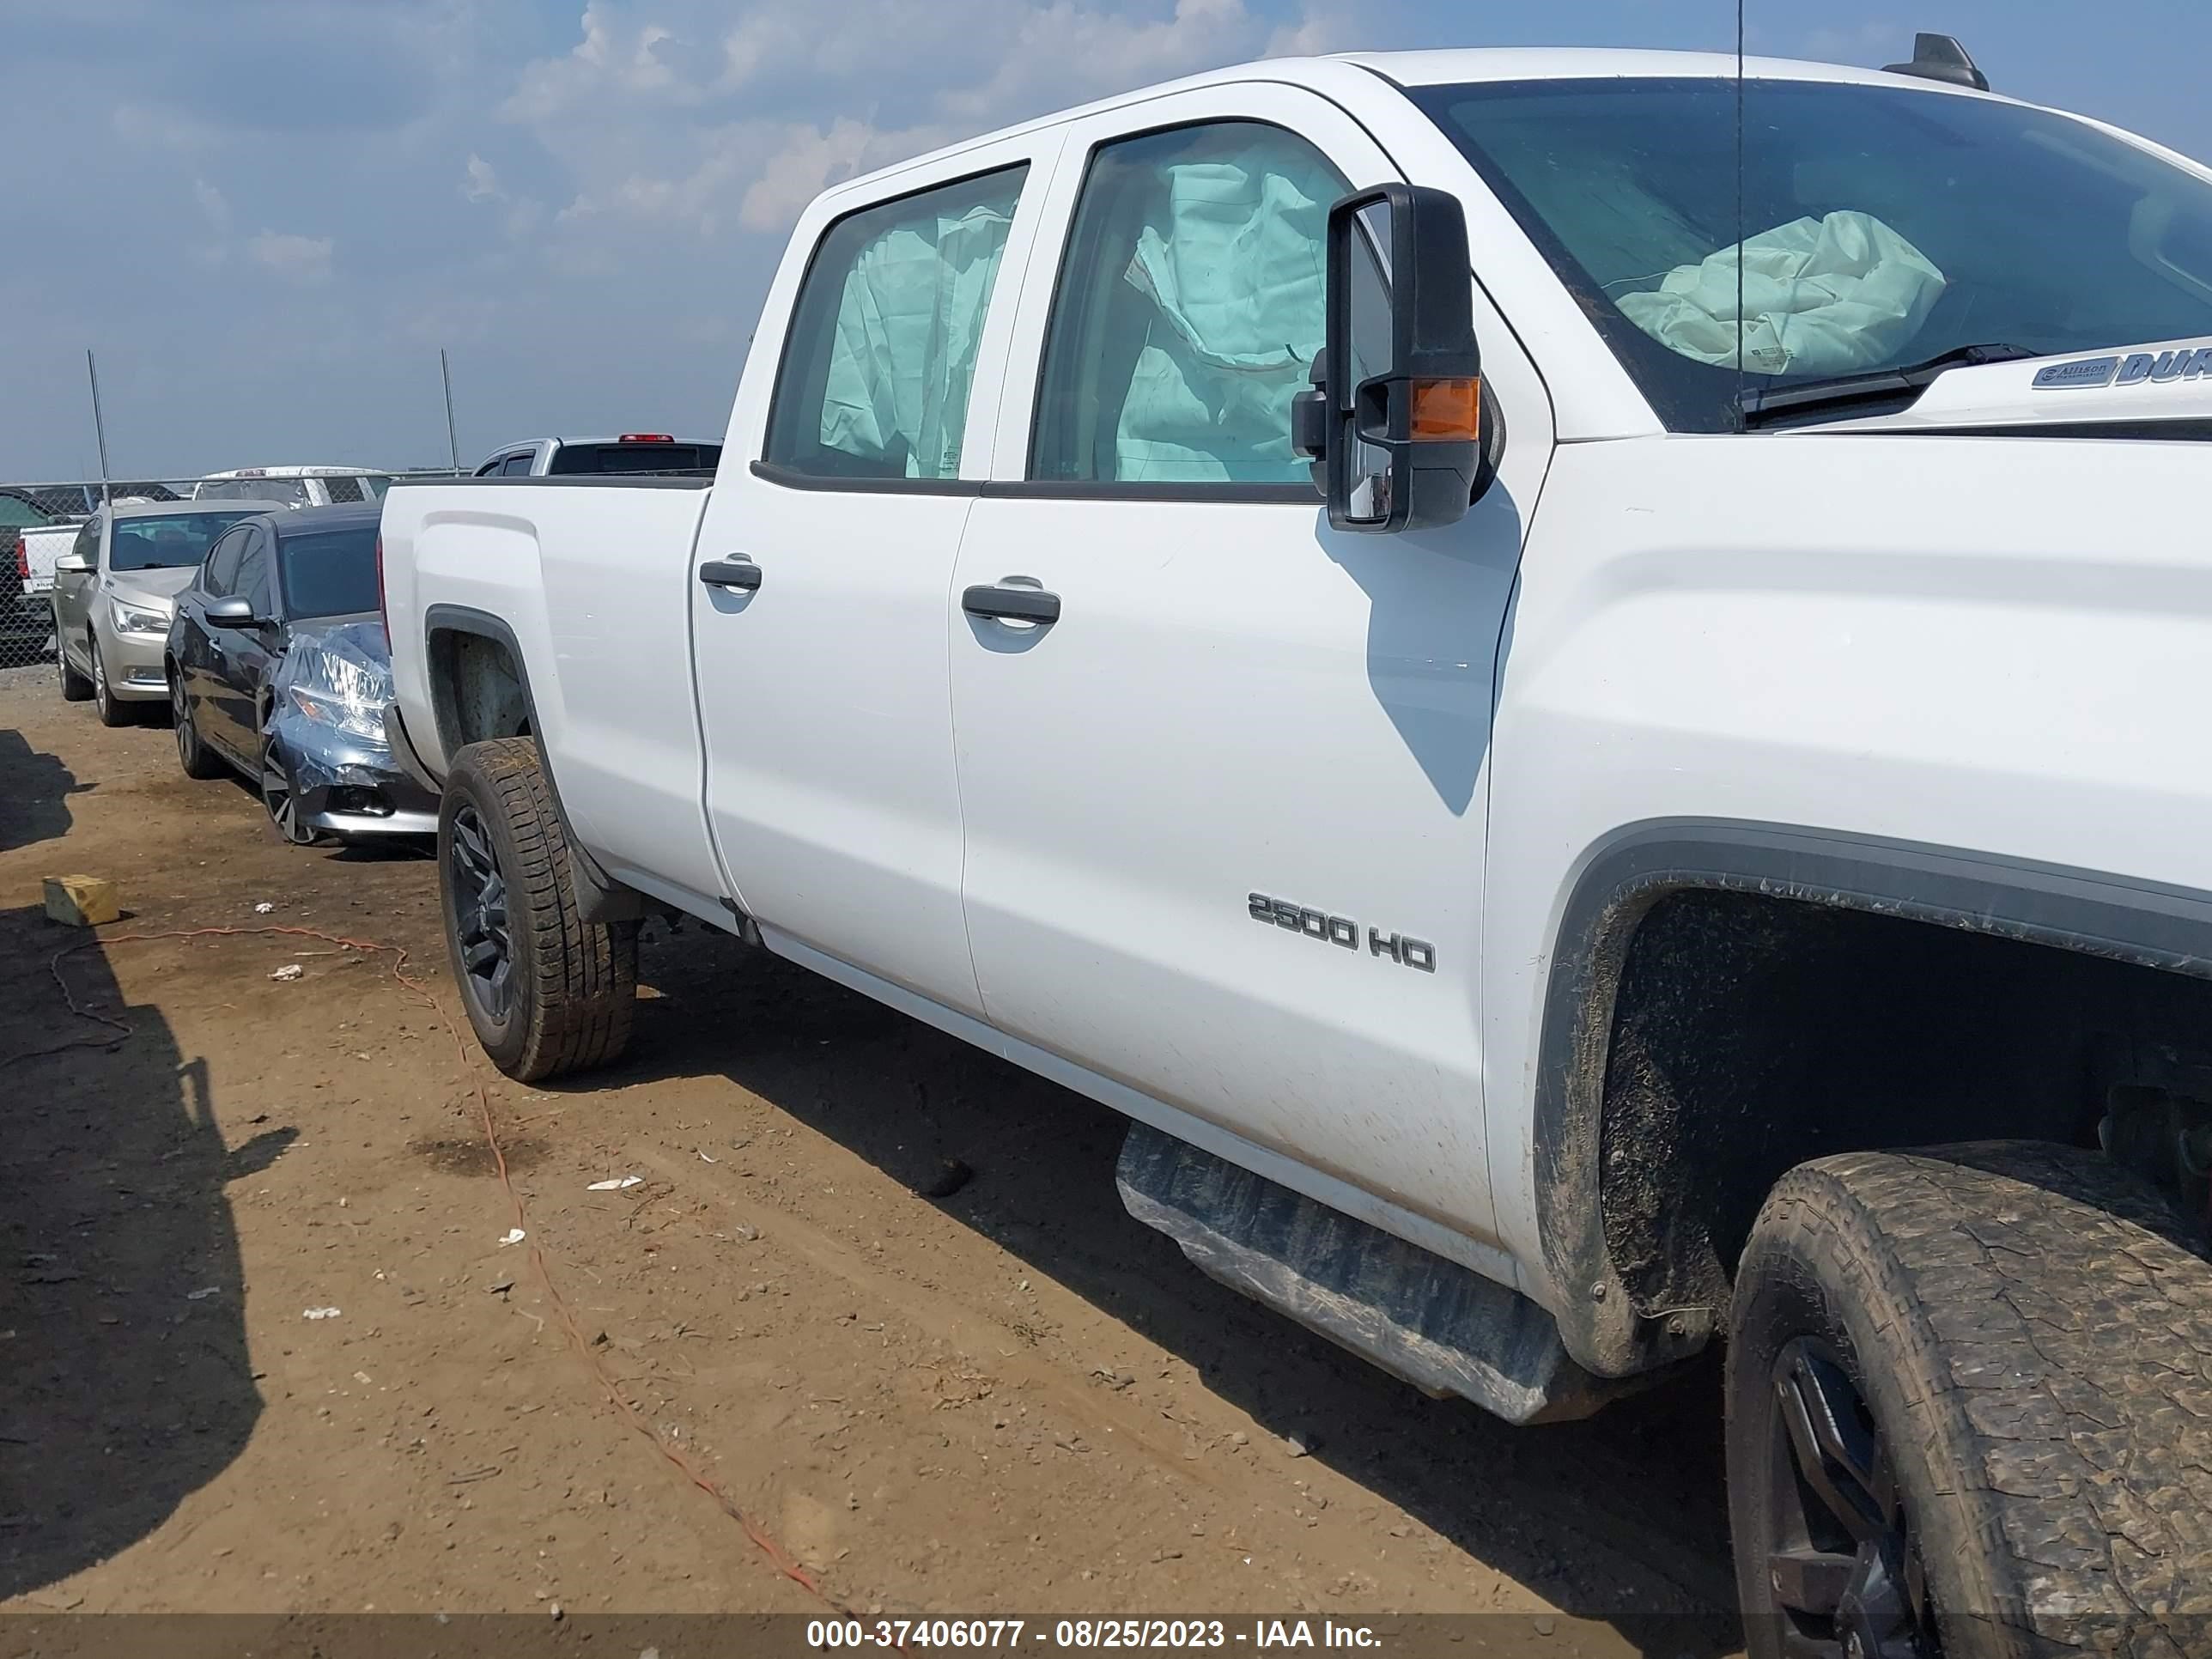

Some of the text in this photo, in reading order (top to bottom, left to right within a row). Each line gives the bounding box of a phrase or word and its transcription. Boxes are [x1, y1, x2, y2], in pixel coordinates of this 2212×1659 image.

[2058, 364, 2107, 375] Allison
[1249, 892, 1437, 974] 2500 HD
